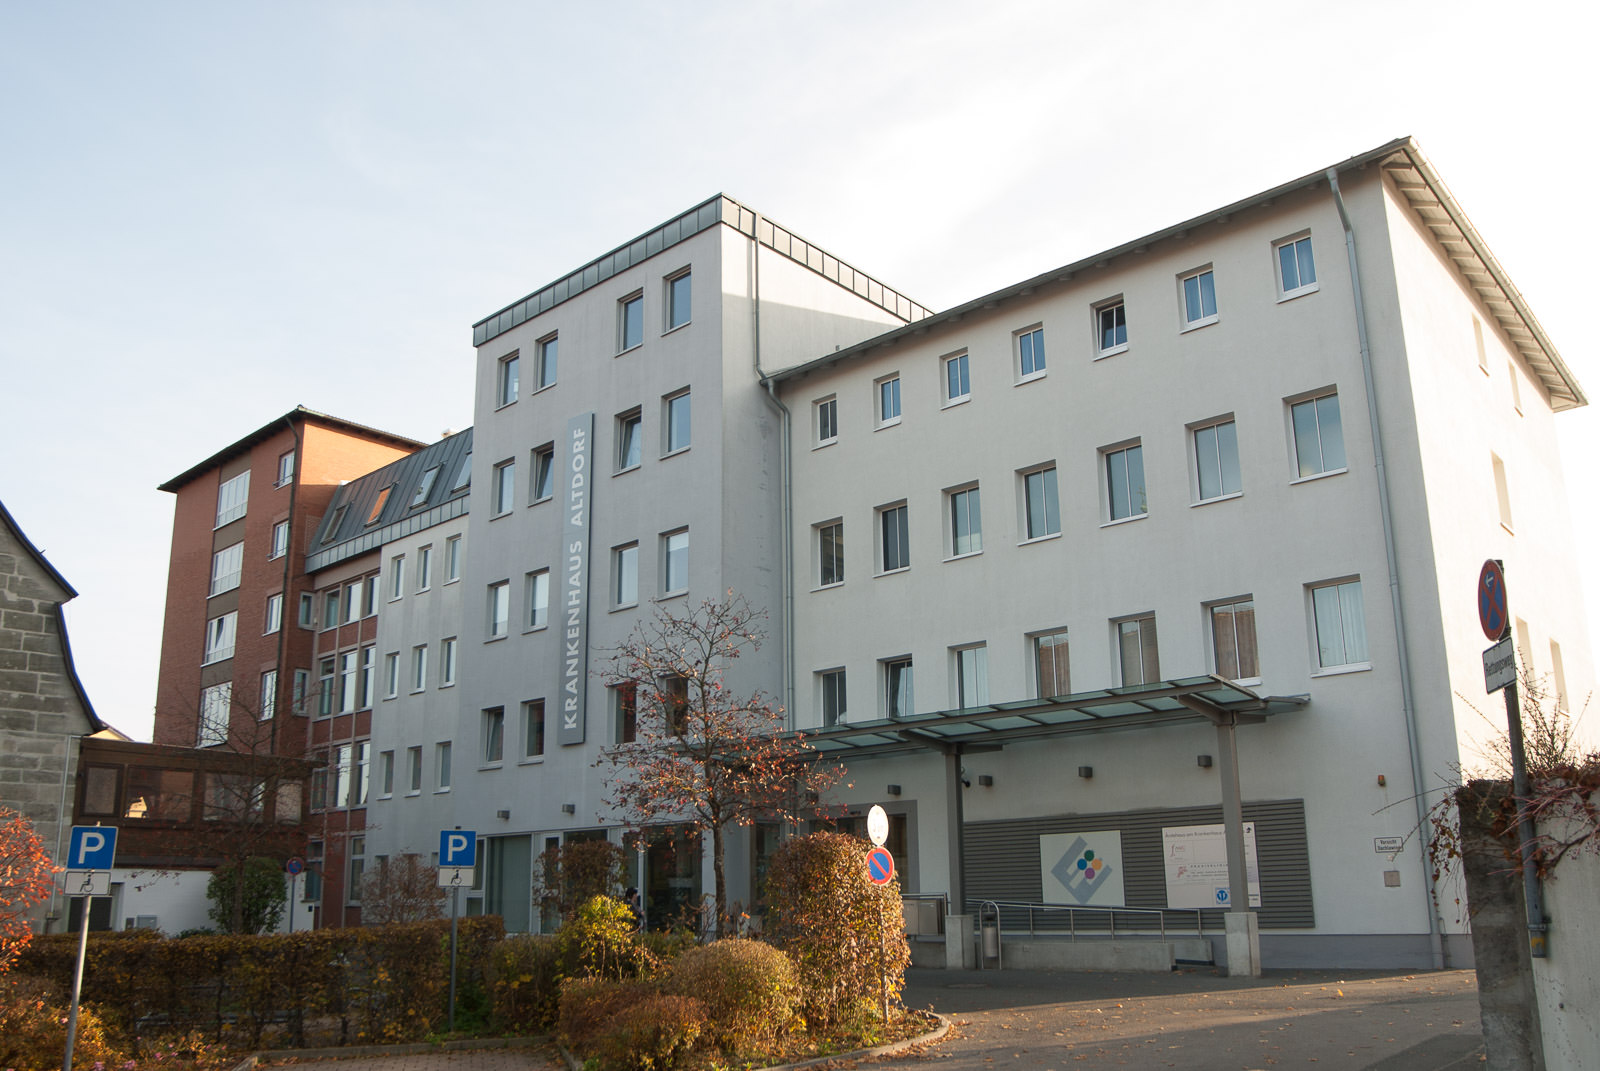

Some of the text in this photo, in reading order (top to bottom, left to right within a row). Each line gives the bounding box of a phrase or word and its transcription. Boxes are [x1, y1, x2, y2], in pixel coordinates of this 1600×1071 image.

[564, 428, 586, 729] KRANKENHAUS ALTDORF
[78, 832, 105, 865] P
[447, 834, 468, 862] P
